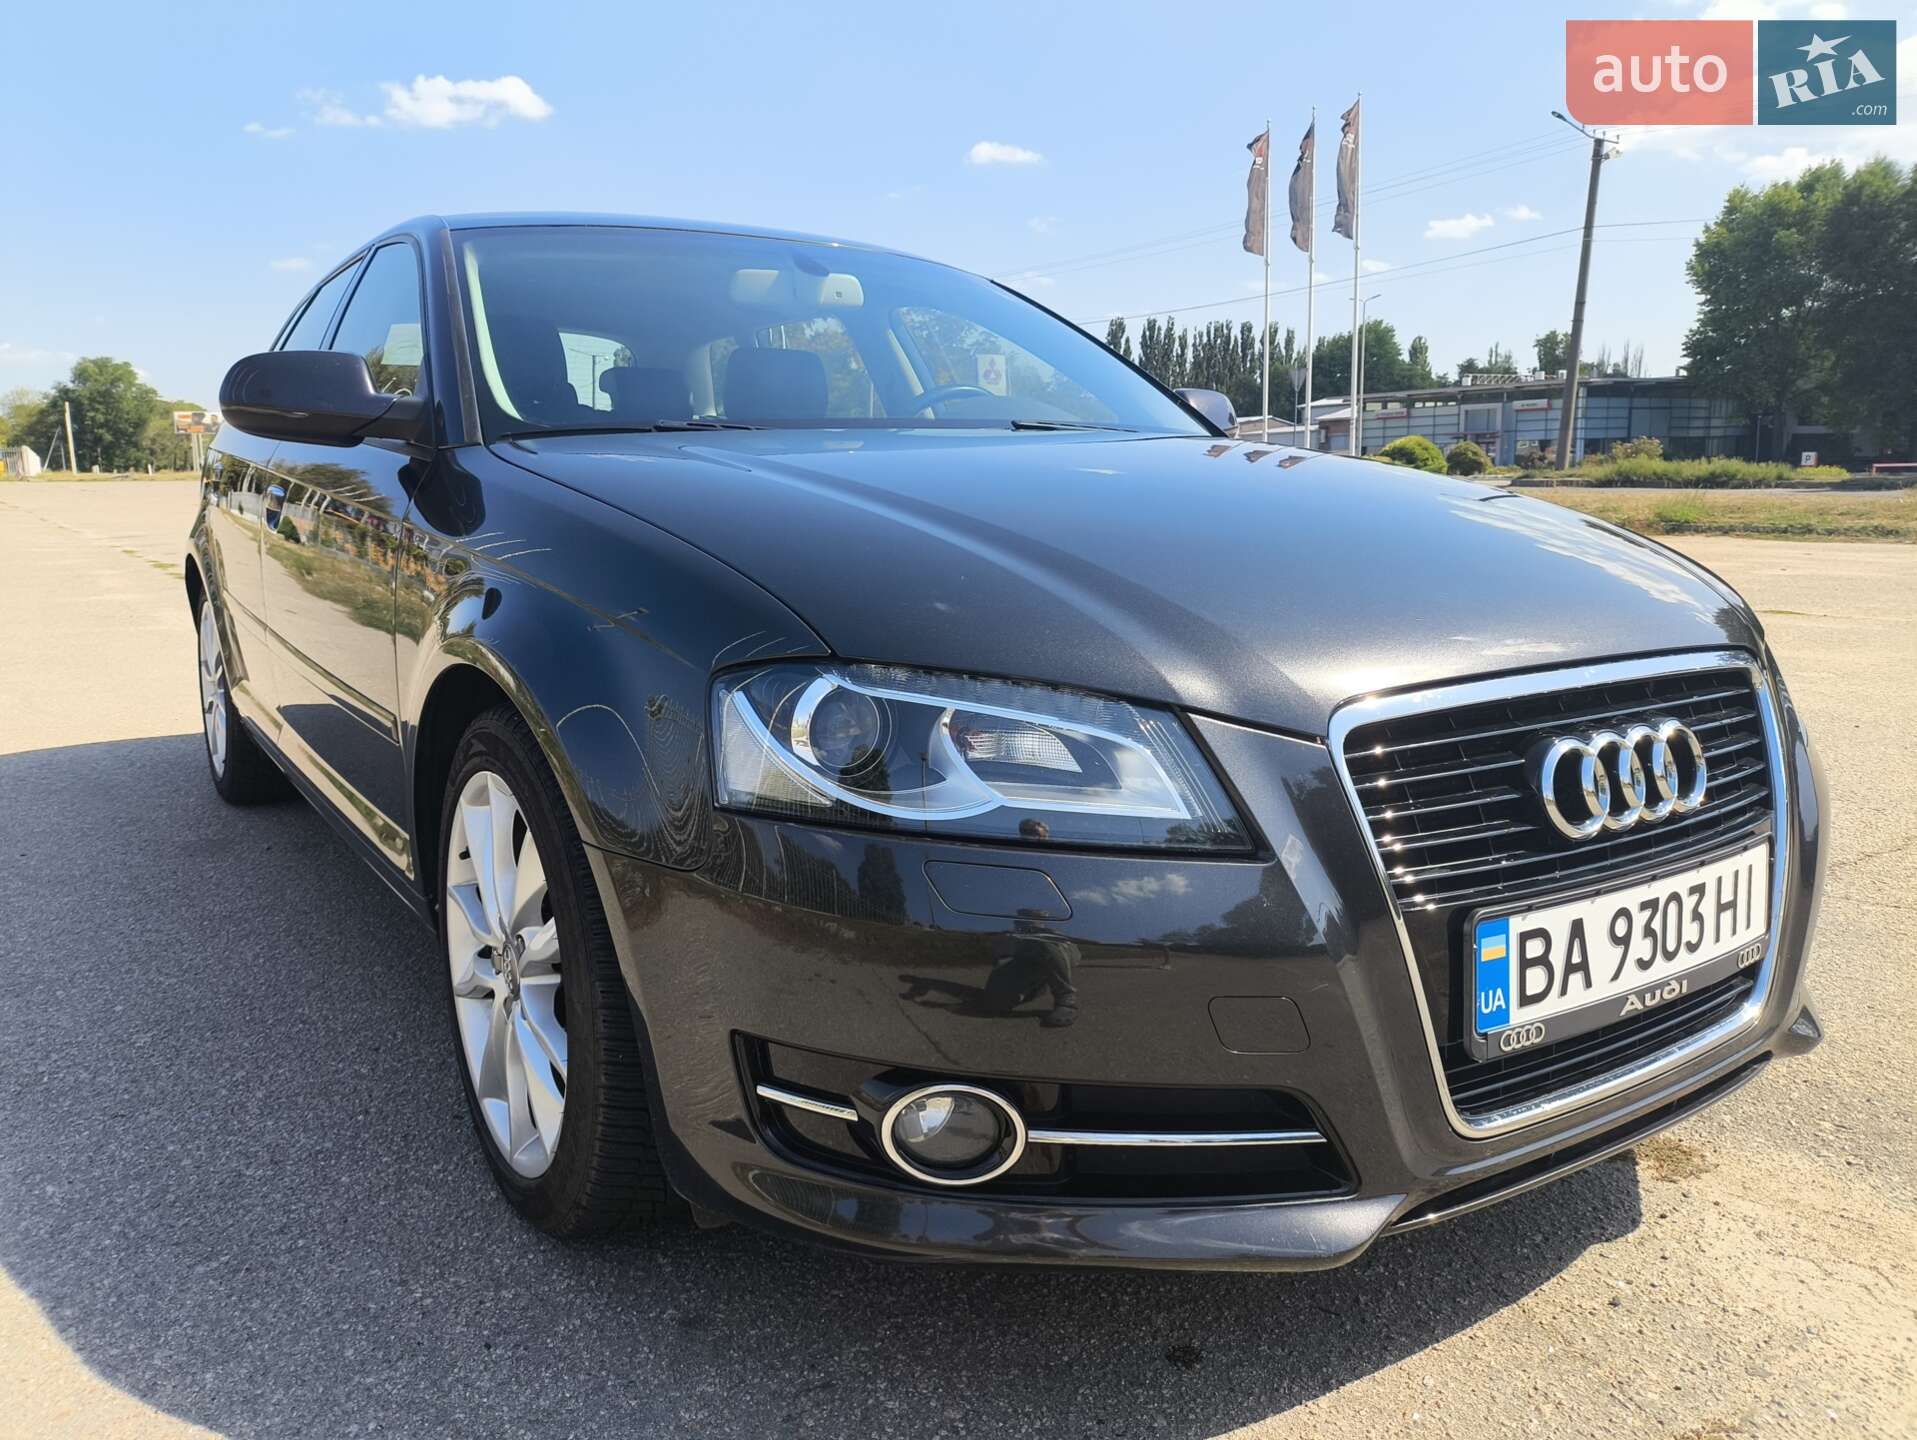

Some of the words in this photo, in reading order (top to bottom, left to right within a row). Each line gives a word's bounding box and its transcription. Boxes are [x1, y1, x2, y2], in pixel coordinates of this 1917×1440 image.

[1517, 916, 1593, 1010] BA
[1608, 881, 1707, 983] 9303
[1713, 863, 1754, 945] HI
[1481, 987, 1506, 1014] UA
